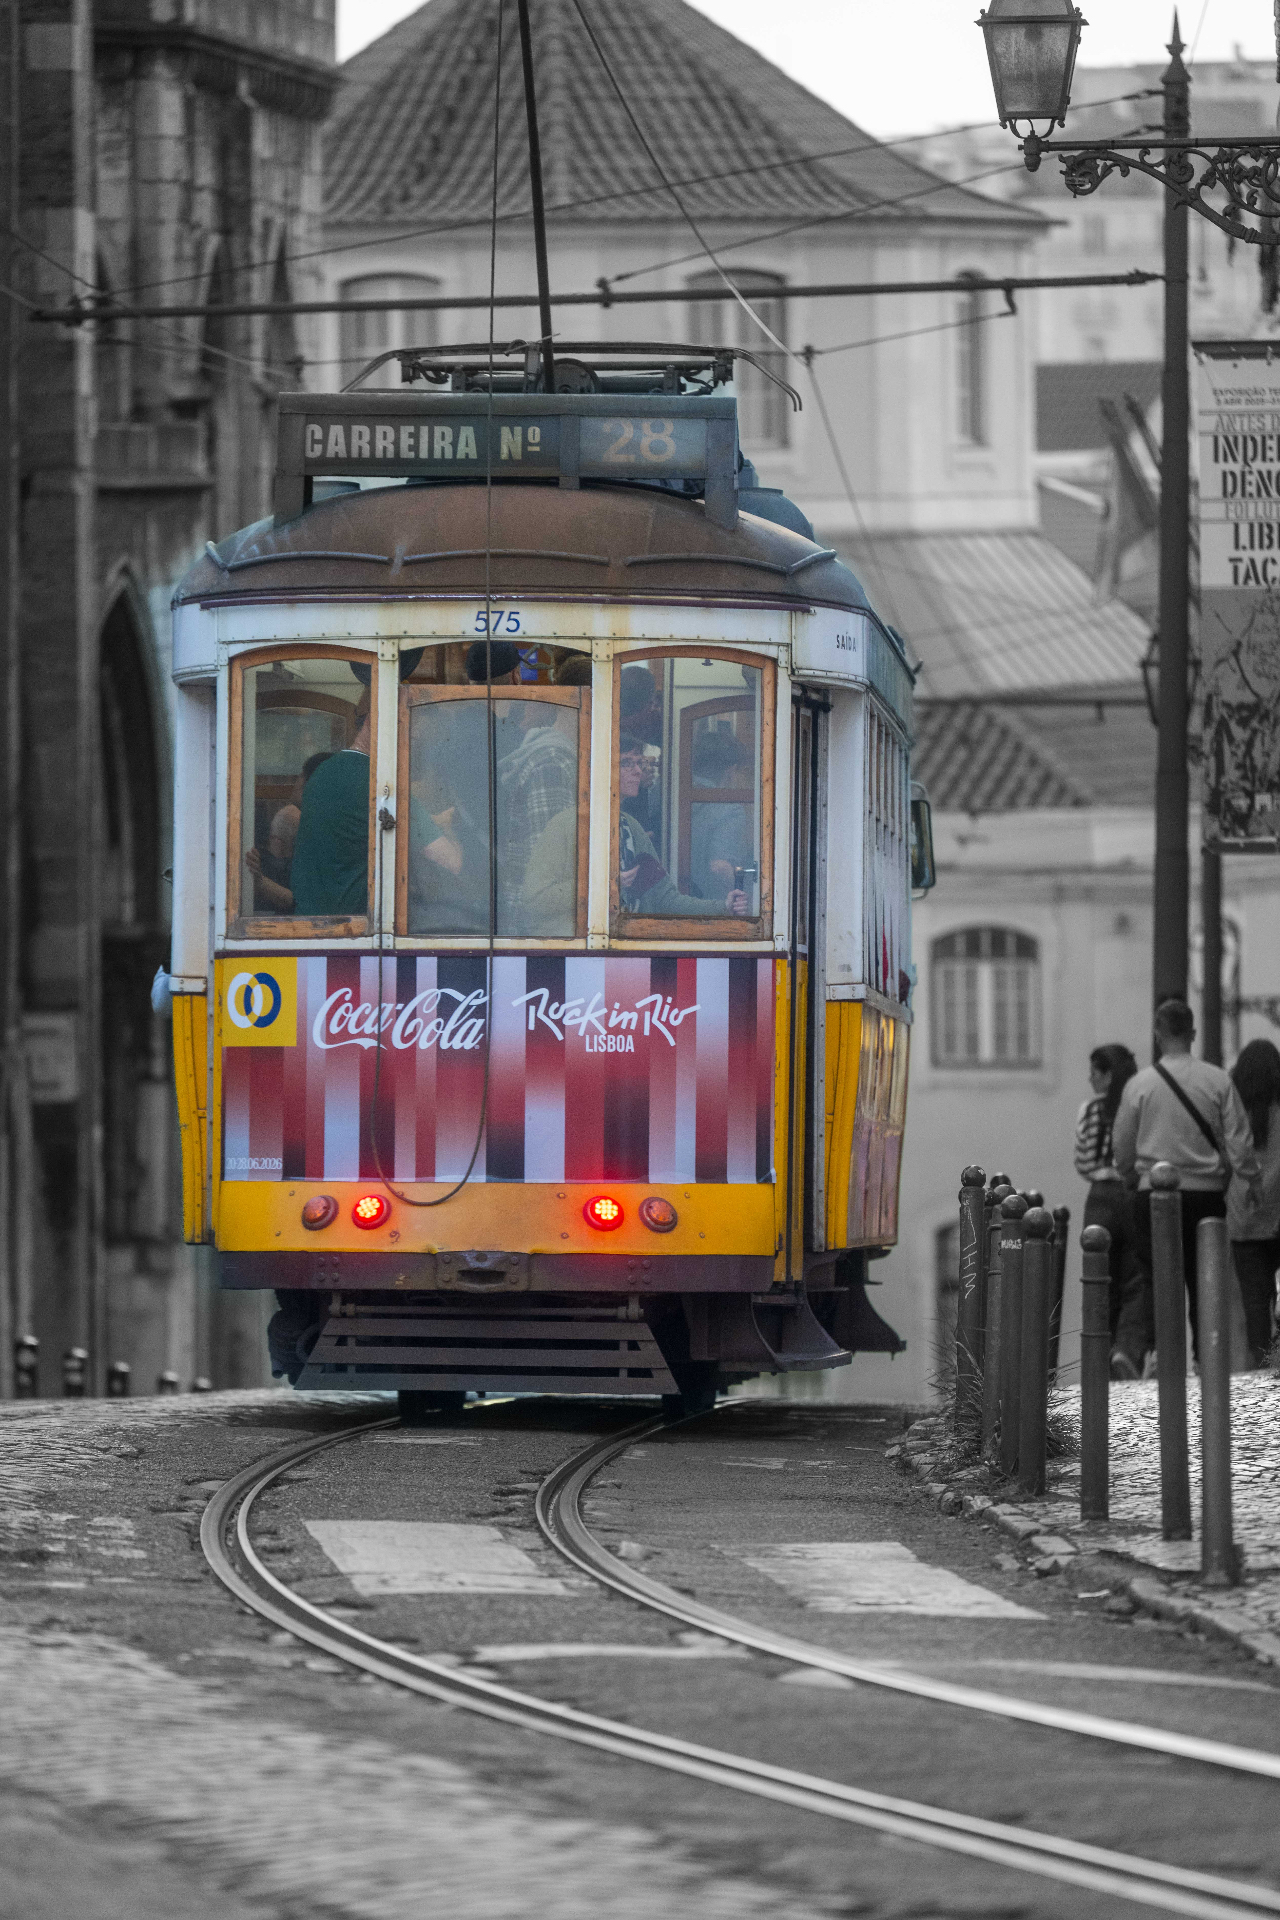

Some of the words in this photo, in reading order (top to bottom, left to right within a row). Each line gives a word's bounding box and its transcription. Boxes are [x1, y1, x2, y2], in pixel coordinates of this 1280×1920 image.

[305, 423, 478, 459] CARREIRA
[500, 425, 541, 460] Nº
[602, 417, 676, 462] 28
[1234, 521, 1280, 551] LIB
[474, 610, 520, 633] 575
[836, 631, 857, 652] SAÍDA
[312, 987, 490, 1050] Coca-Cola
[511, 988, 608, 1041] Rock
[608, 1002, 638, 1030] in
[635, 993, 701, 1047] Rio
[585, 1034, 635, 1053] LISBOA
